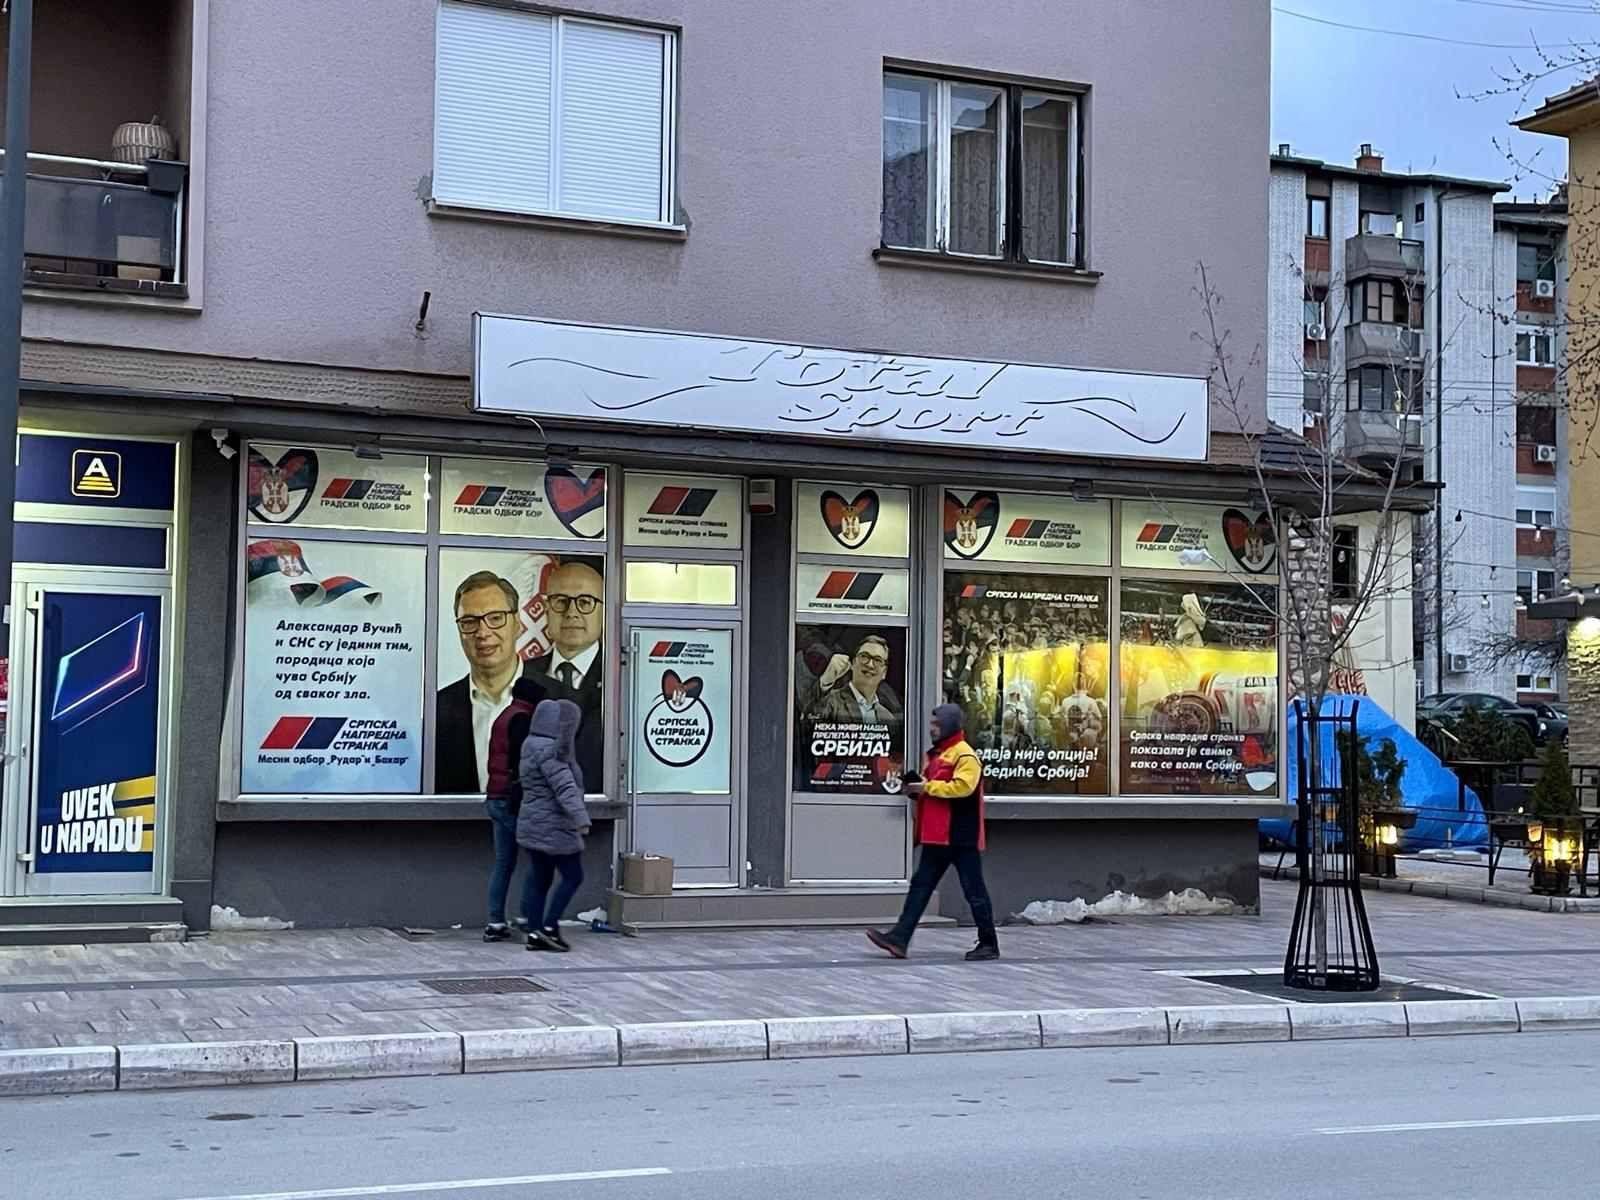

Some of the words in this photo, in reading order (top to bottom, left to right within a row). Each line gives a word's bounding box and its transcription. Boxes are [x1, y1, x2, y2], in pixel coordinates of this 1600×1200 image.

[776, 393, 1045, 436] Sport
[320, 500, 359, 508] ГРАДСКИ
[362, 502, 391, 510] ОДБОР
[453, 507, 492, 515] ГРАДСКИ
[494, 508, 523, 517] ОДБОР
[1005, 538, 1038, 546] ГРАДСКИ
[1039, 541, 1064, 549] ОДБОР
[1136, 543, 1168, 551] ГРАДСКИ
[985, 590, 1018, 599] СРПСКА
[1019, 592, 1063, 600] НАПРЕДНА
[1063, 593, 1099, 602] СТРАНКА
[276, 620, 358, 635] Александар
[362, 622, 402, 636] Вучић
[275, 638, 284, 647] и
[288, 637, 316, 648] СНС
[318, 640, 333, 651] су
[336, 638, 381, 651] једини
[385, 642, 412, 652] тим,
[275, 655, 343, 667] породица
[347, 655, 375, 668] која
[275, 672, 307, 684] чува
[311, 671, 357, 685] Србију
[274, 689, 292, 700] од
[296, 690, 340, 699] сваког
[343, 690, 371, 699] зла.
[349, 720, 397, 729] СРПСКА
[658, 718, 698, 726] СРПСКА
[814, 722, 837, 731] НЕКА
[341, 731, 408, 739] НАПРЕДНА
[650, 728, 706, 736] НАПРЕДНА
[812, 731, 850, 740] ПРЕЛЕПА
[1130, 730, 1162, 743] Српска
[1163, 732, 1208, 742] напредна
[1209, 734, 1246, 743] странка
[333, 741, 389, 750] СТРАНКА
[655, 738, 701, 746] СТРАНКА
[811, 740, 891, 757] СРБИЈА!
[1130, 745, 1185, 756] показала
[1186, 745, 1197, 758] је
[1199, 747, 1233, 756] свима
[258, 754, 290, 763] Месни
[293, 754, 325, 765] одбор
[1014, 746, 1045, 763] није
[1047, 746, 1099, 763] опција!
[1130, 760, 1158, 769] како
[1160, 761, 1173, 769] се
[1175, 761, 1202, 769] воли
[1205, 759, 1246, 771] Србија.
[1037, 764, 1090, 780] Србија!
[61, 782, 117, 822] UVEK
[40, 825, 54, 854] U
[56, 816, 144, 854] NAPADU
